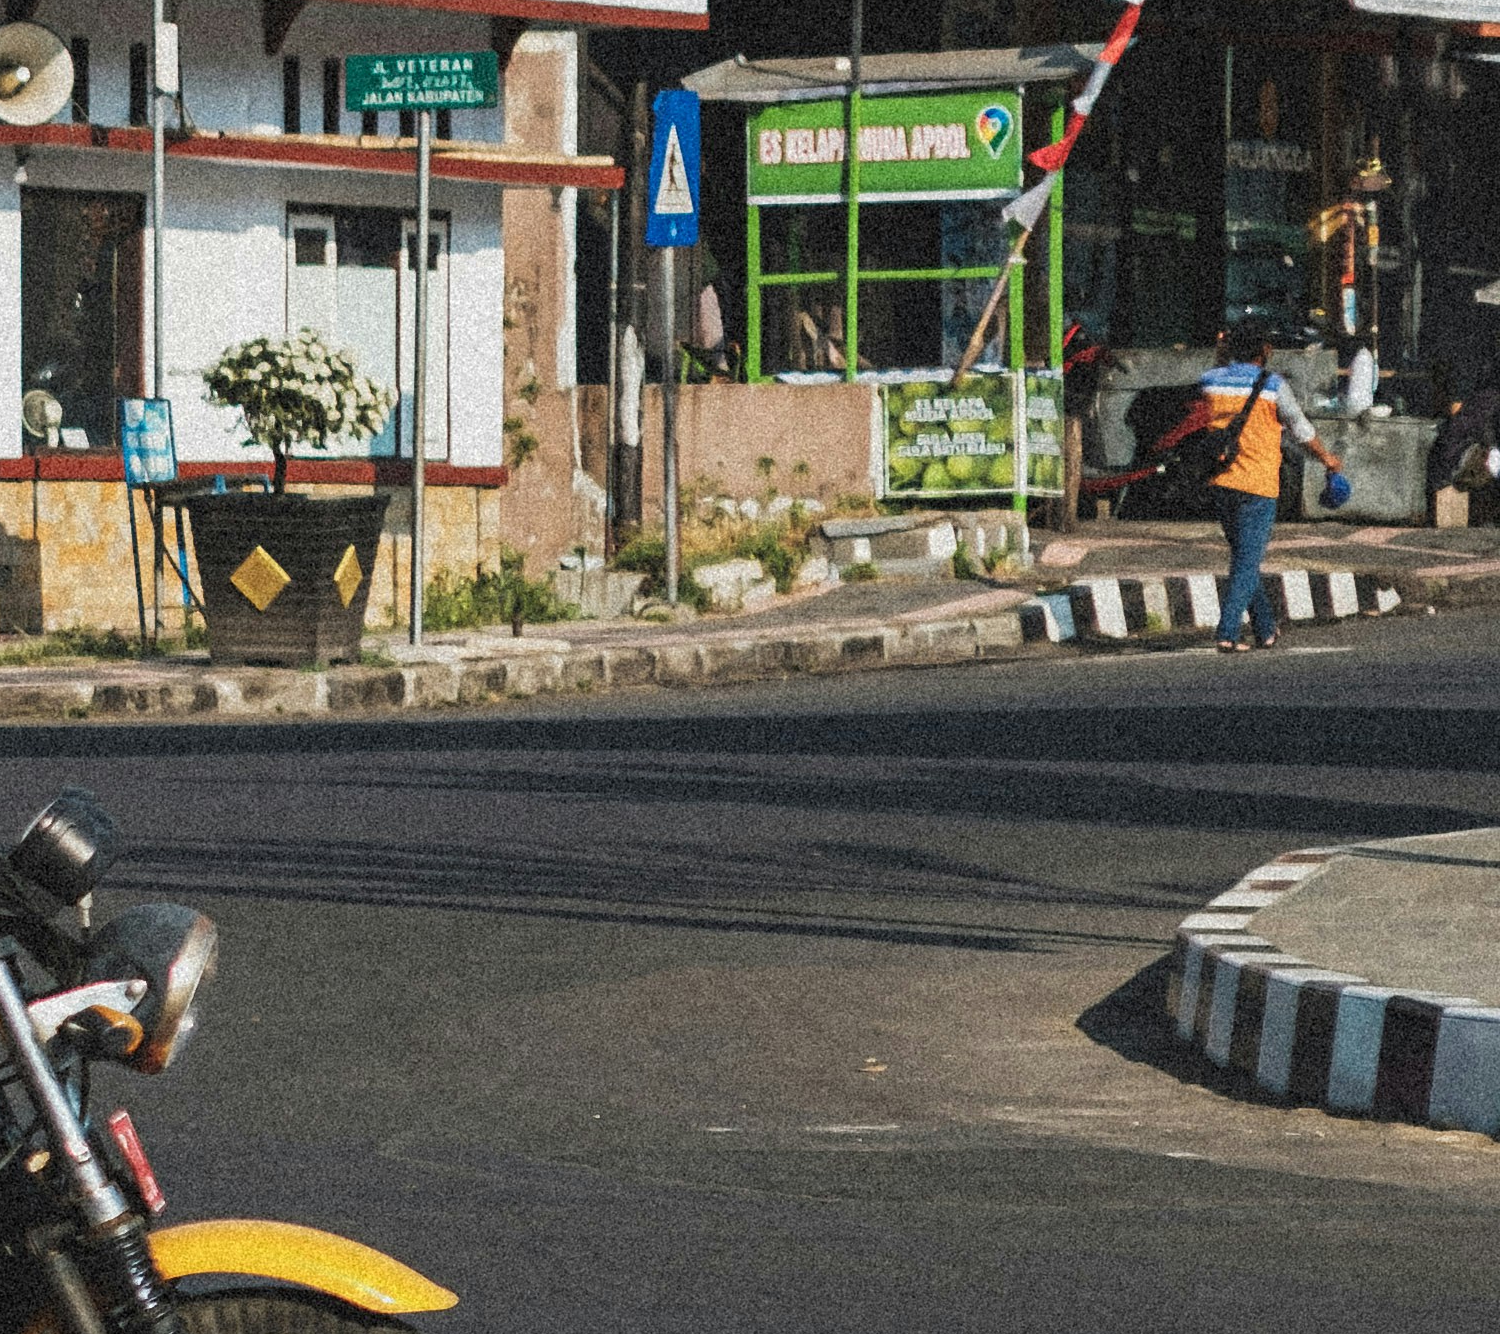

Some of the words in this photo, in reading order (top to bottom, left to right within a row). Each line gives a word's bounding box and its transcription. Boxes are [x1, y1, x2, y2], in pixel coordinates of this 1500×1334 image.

[396, 57, 473, 74] VETERAN
[362, 90, 403, 106] JALAN
[759, 128, 783, 165] ES
[785, 127, 845, 164] KELAP
